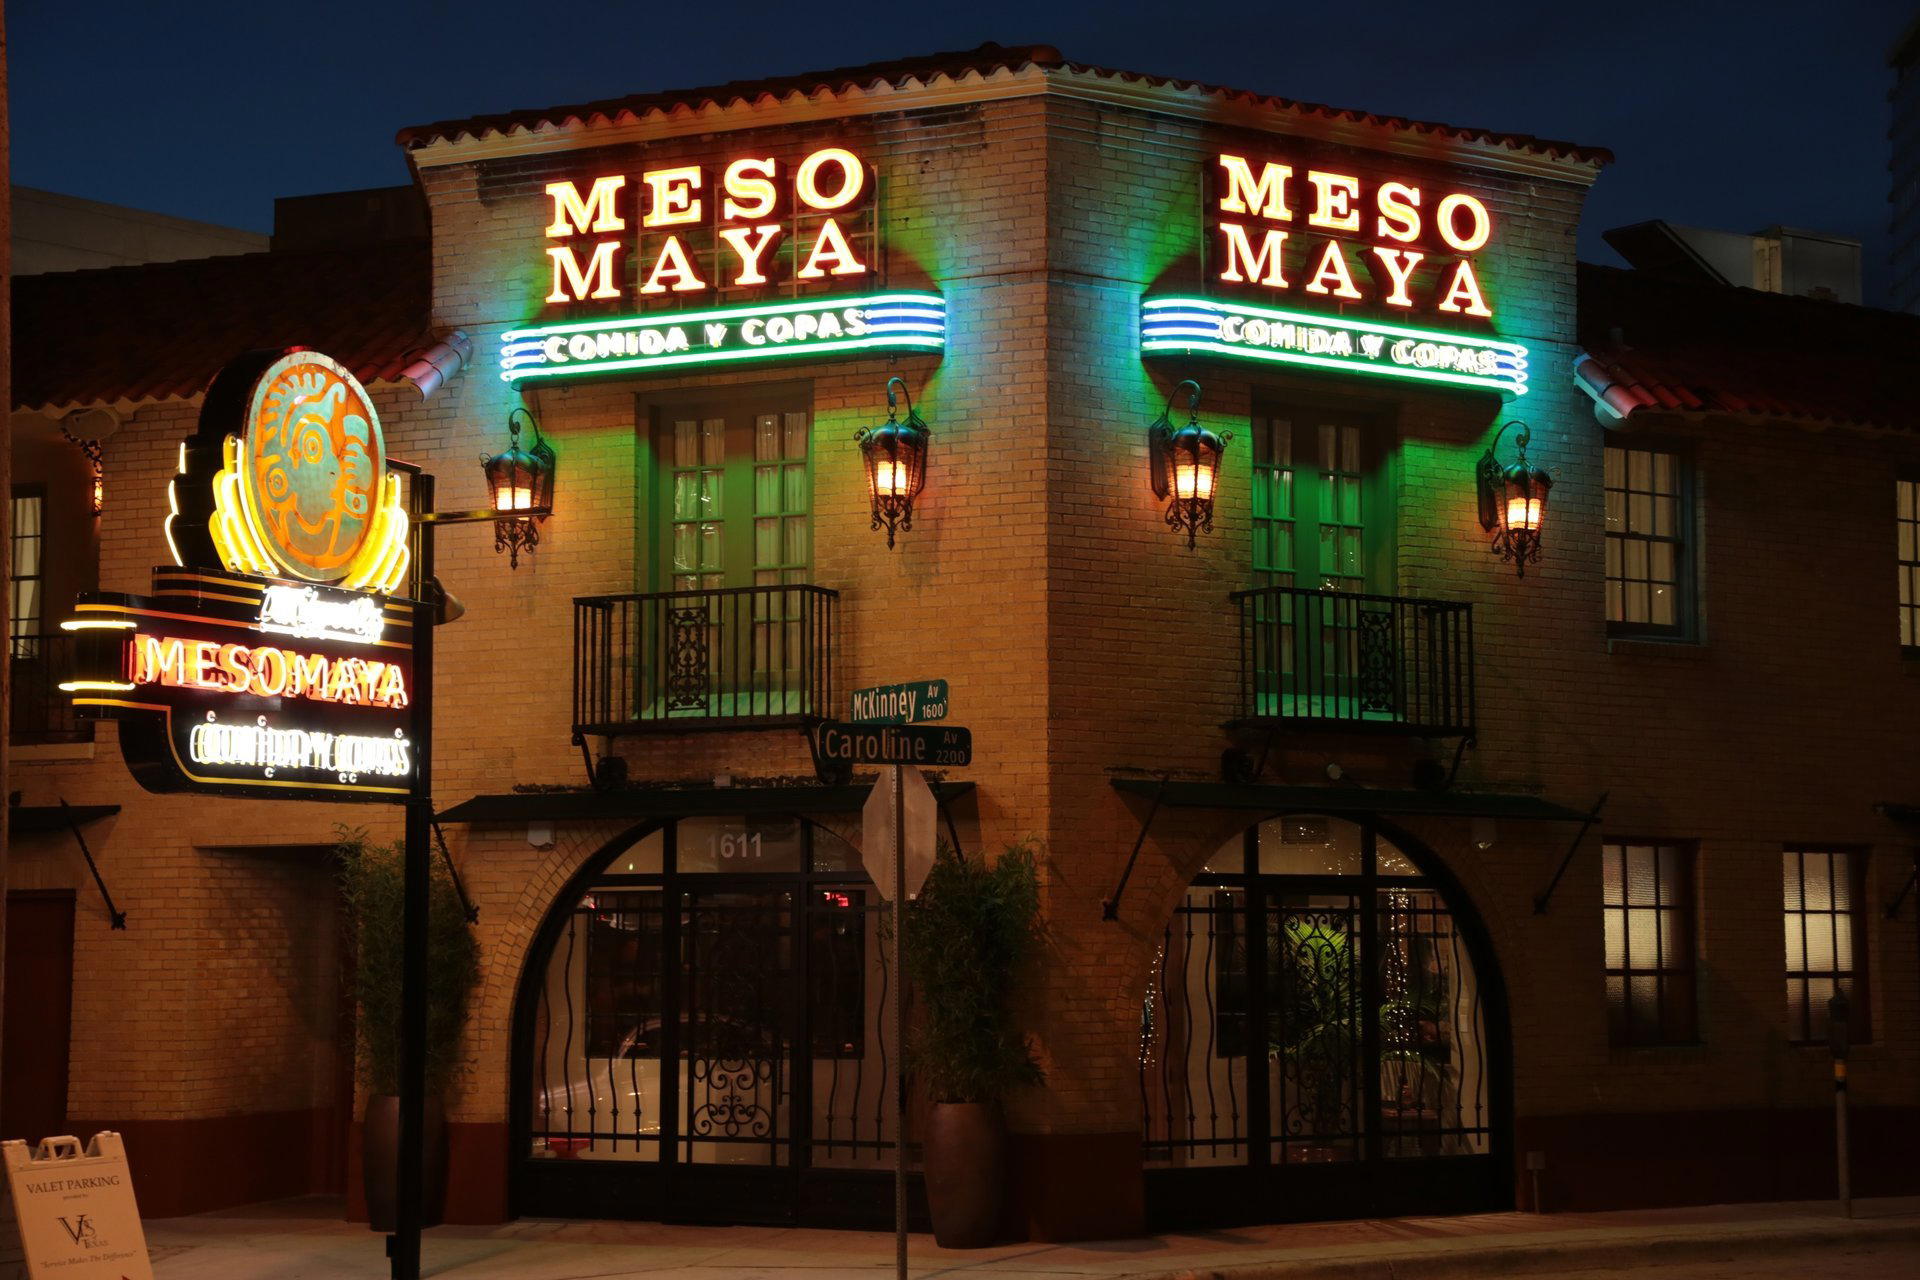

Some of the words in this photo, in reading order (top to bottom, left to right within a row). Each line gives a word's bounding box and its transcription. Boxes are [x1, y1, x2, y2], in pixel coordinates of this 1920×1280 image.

[545, 147, 865, 239] MESO
[1219, 153, 1492, 253] MESO
[545, 217, 867, 304] MAYA
[1219, 222, 1493, 318] MAYA
[543, 326, 690, 363] COMIDA
[704, 322, 729, 348] Y
[740, 307, 872, 347] COPAS
[1219, 316, 1353, 357] COMIDA
[1359, 334, 1385, 360] Y
[1390, 338, 1499, 375] COPAS
[853, 687, 917, 723] McKinney
[927, 684, 940, 699] Av
[921, 703, 945, 719] 1600
[825, 729, 926, 761] Caroline
[943, 730, 959, 745] Av
[936, 749, 966, 765] 2200
[706, 832, 762, 858] 1611
[26, 1180, 64, 1194] VALET
[66, 1175, 120, 1190] PARKING
